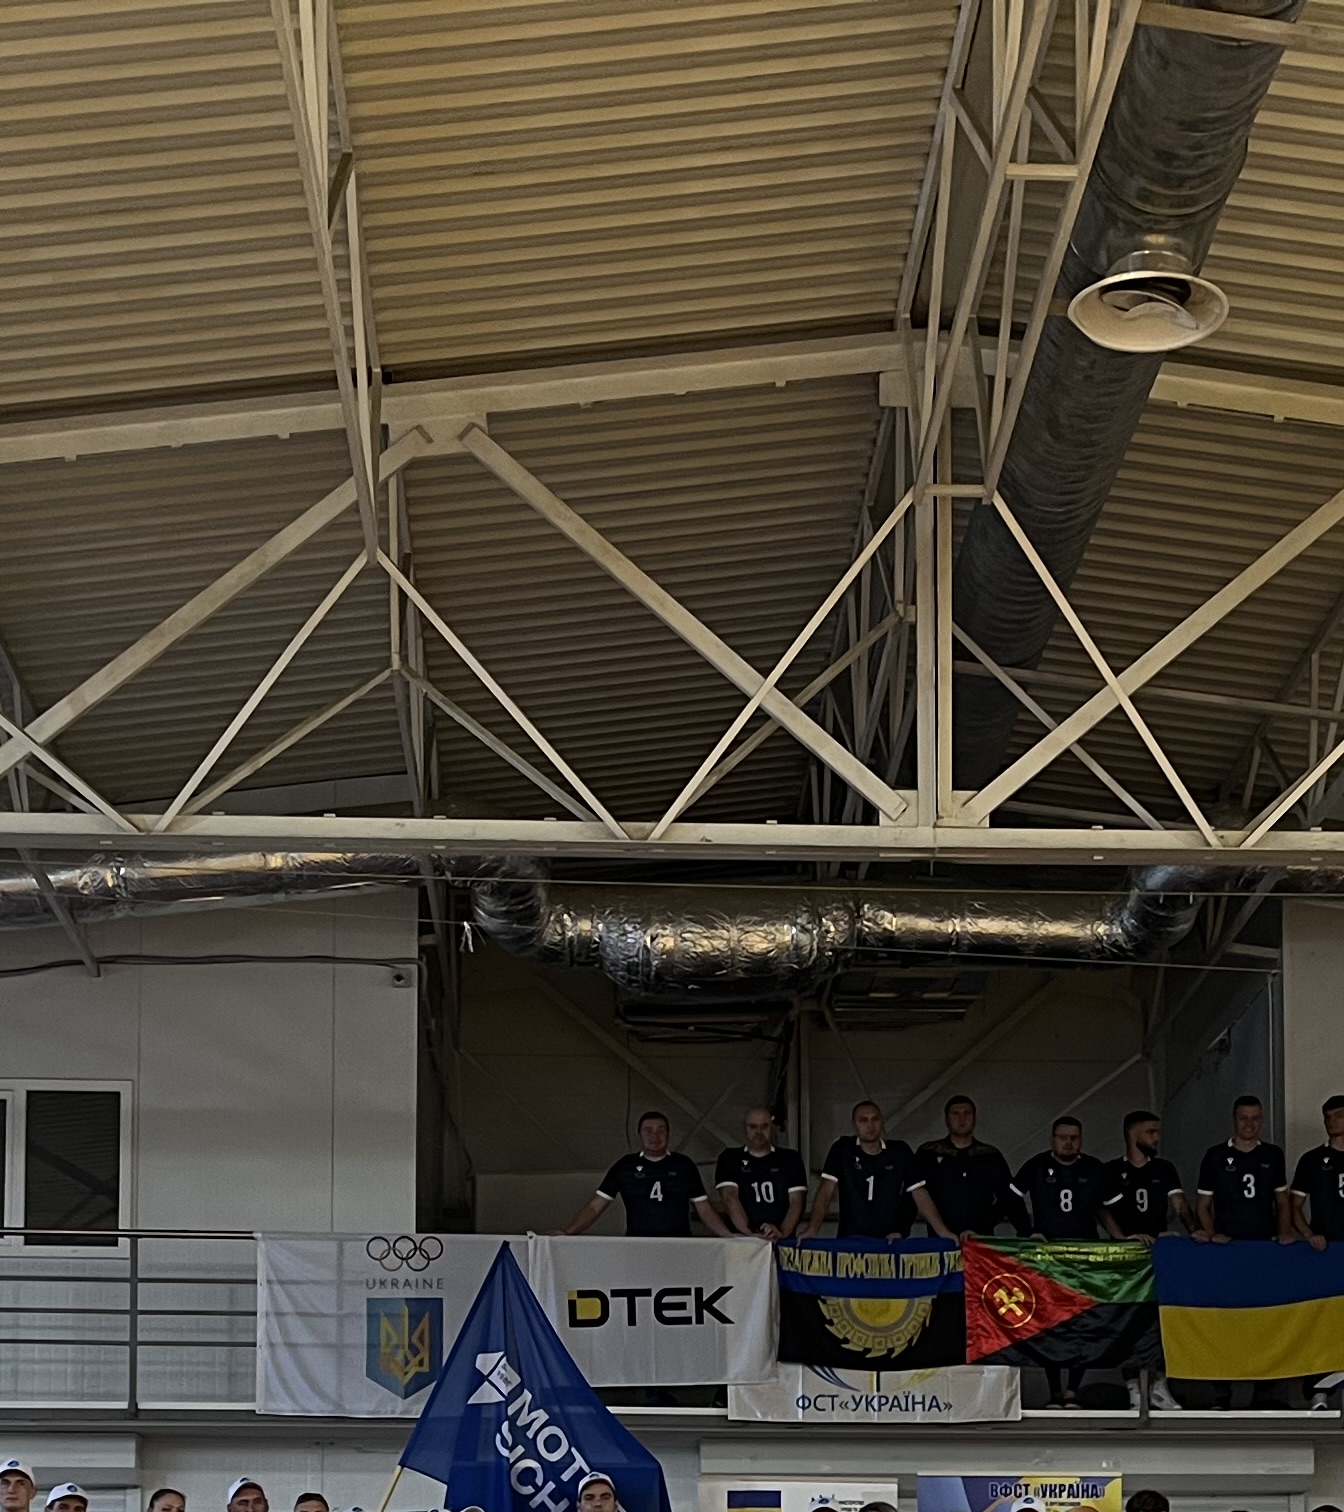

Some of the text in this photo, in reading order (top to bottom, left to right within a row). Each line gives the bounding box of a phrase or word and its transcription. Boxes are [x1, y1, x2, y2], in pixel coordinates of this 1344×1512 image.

[649, 1181, 663, 1202] 4
[751, 1181, 775, 1203] 10
[864, 1175, 875, 1201] 1
[1243, 1173, 1256, 1199] 3
[1060, 1189, 1074, 1213] 8
[1135, 1188, 1149, 1213] 9
[365, 1277, 445, 1290] UKRAINE
[567, 1286, 736, 1328] DTEK
[795, 1390, 953, 1413] ФСТ«УКРАЇНА»
[989, 1482, 1031, 1498] ВФСТ
